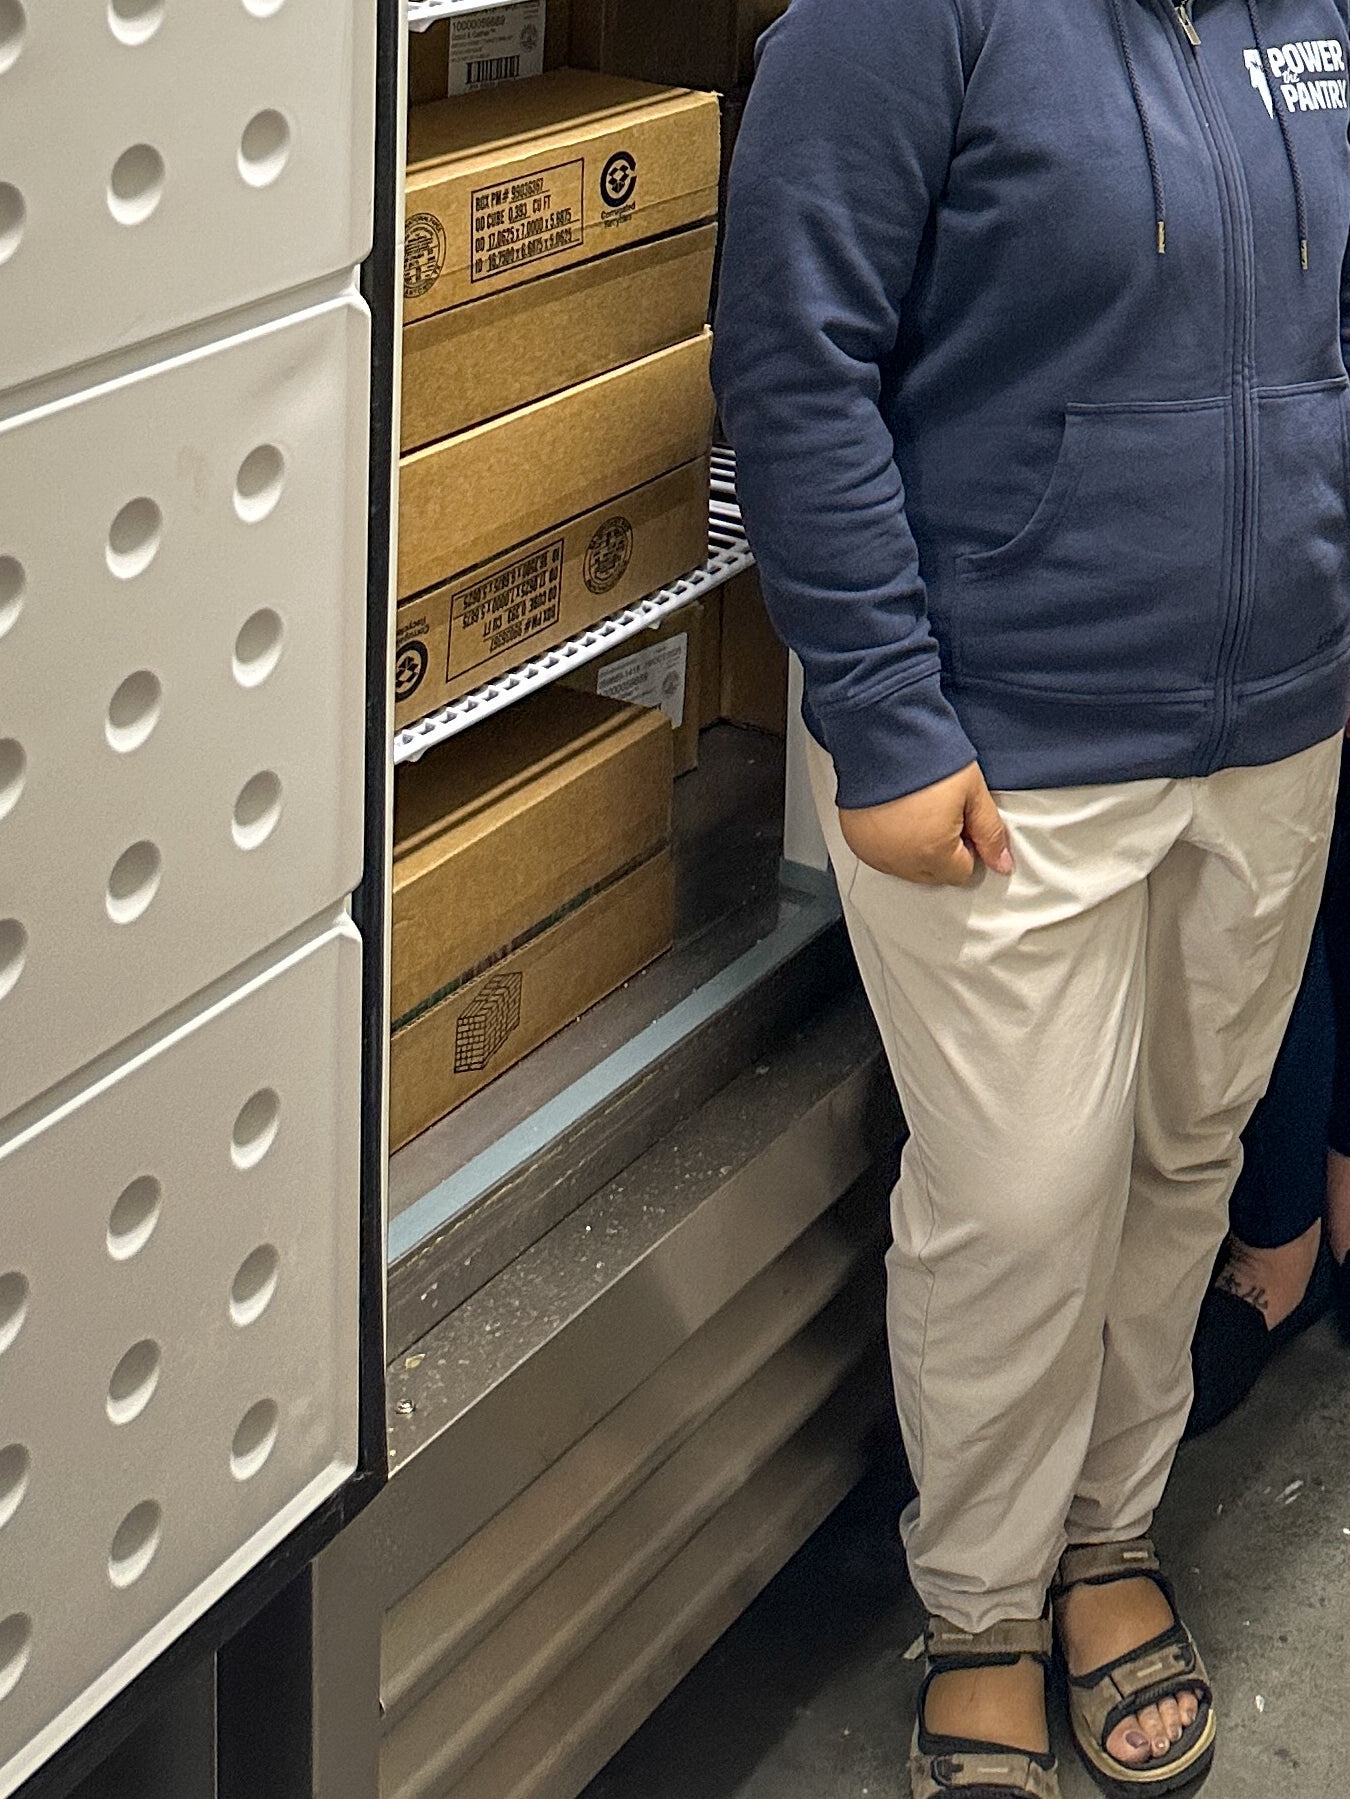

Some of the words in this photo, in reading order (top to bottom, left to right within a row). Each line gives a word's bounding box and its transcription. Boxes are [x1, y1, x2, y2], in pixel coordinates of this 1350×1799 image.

[1266, 39, 1345, 78] POWER
[1281, 67, 1300, 84] the
[1280, 79, 1347, 113] PANTRY
[476, 194, 489, 212] BOX
[486, 209, 505, 230] CUBE
[533, 199, 543, 215] CU
[544, 195, 552, 211] FT
